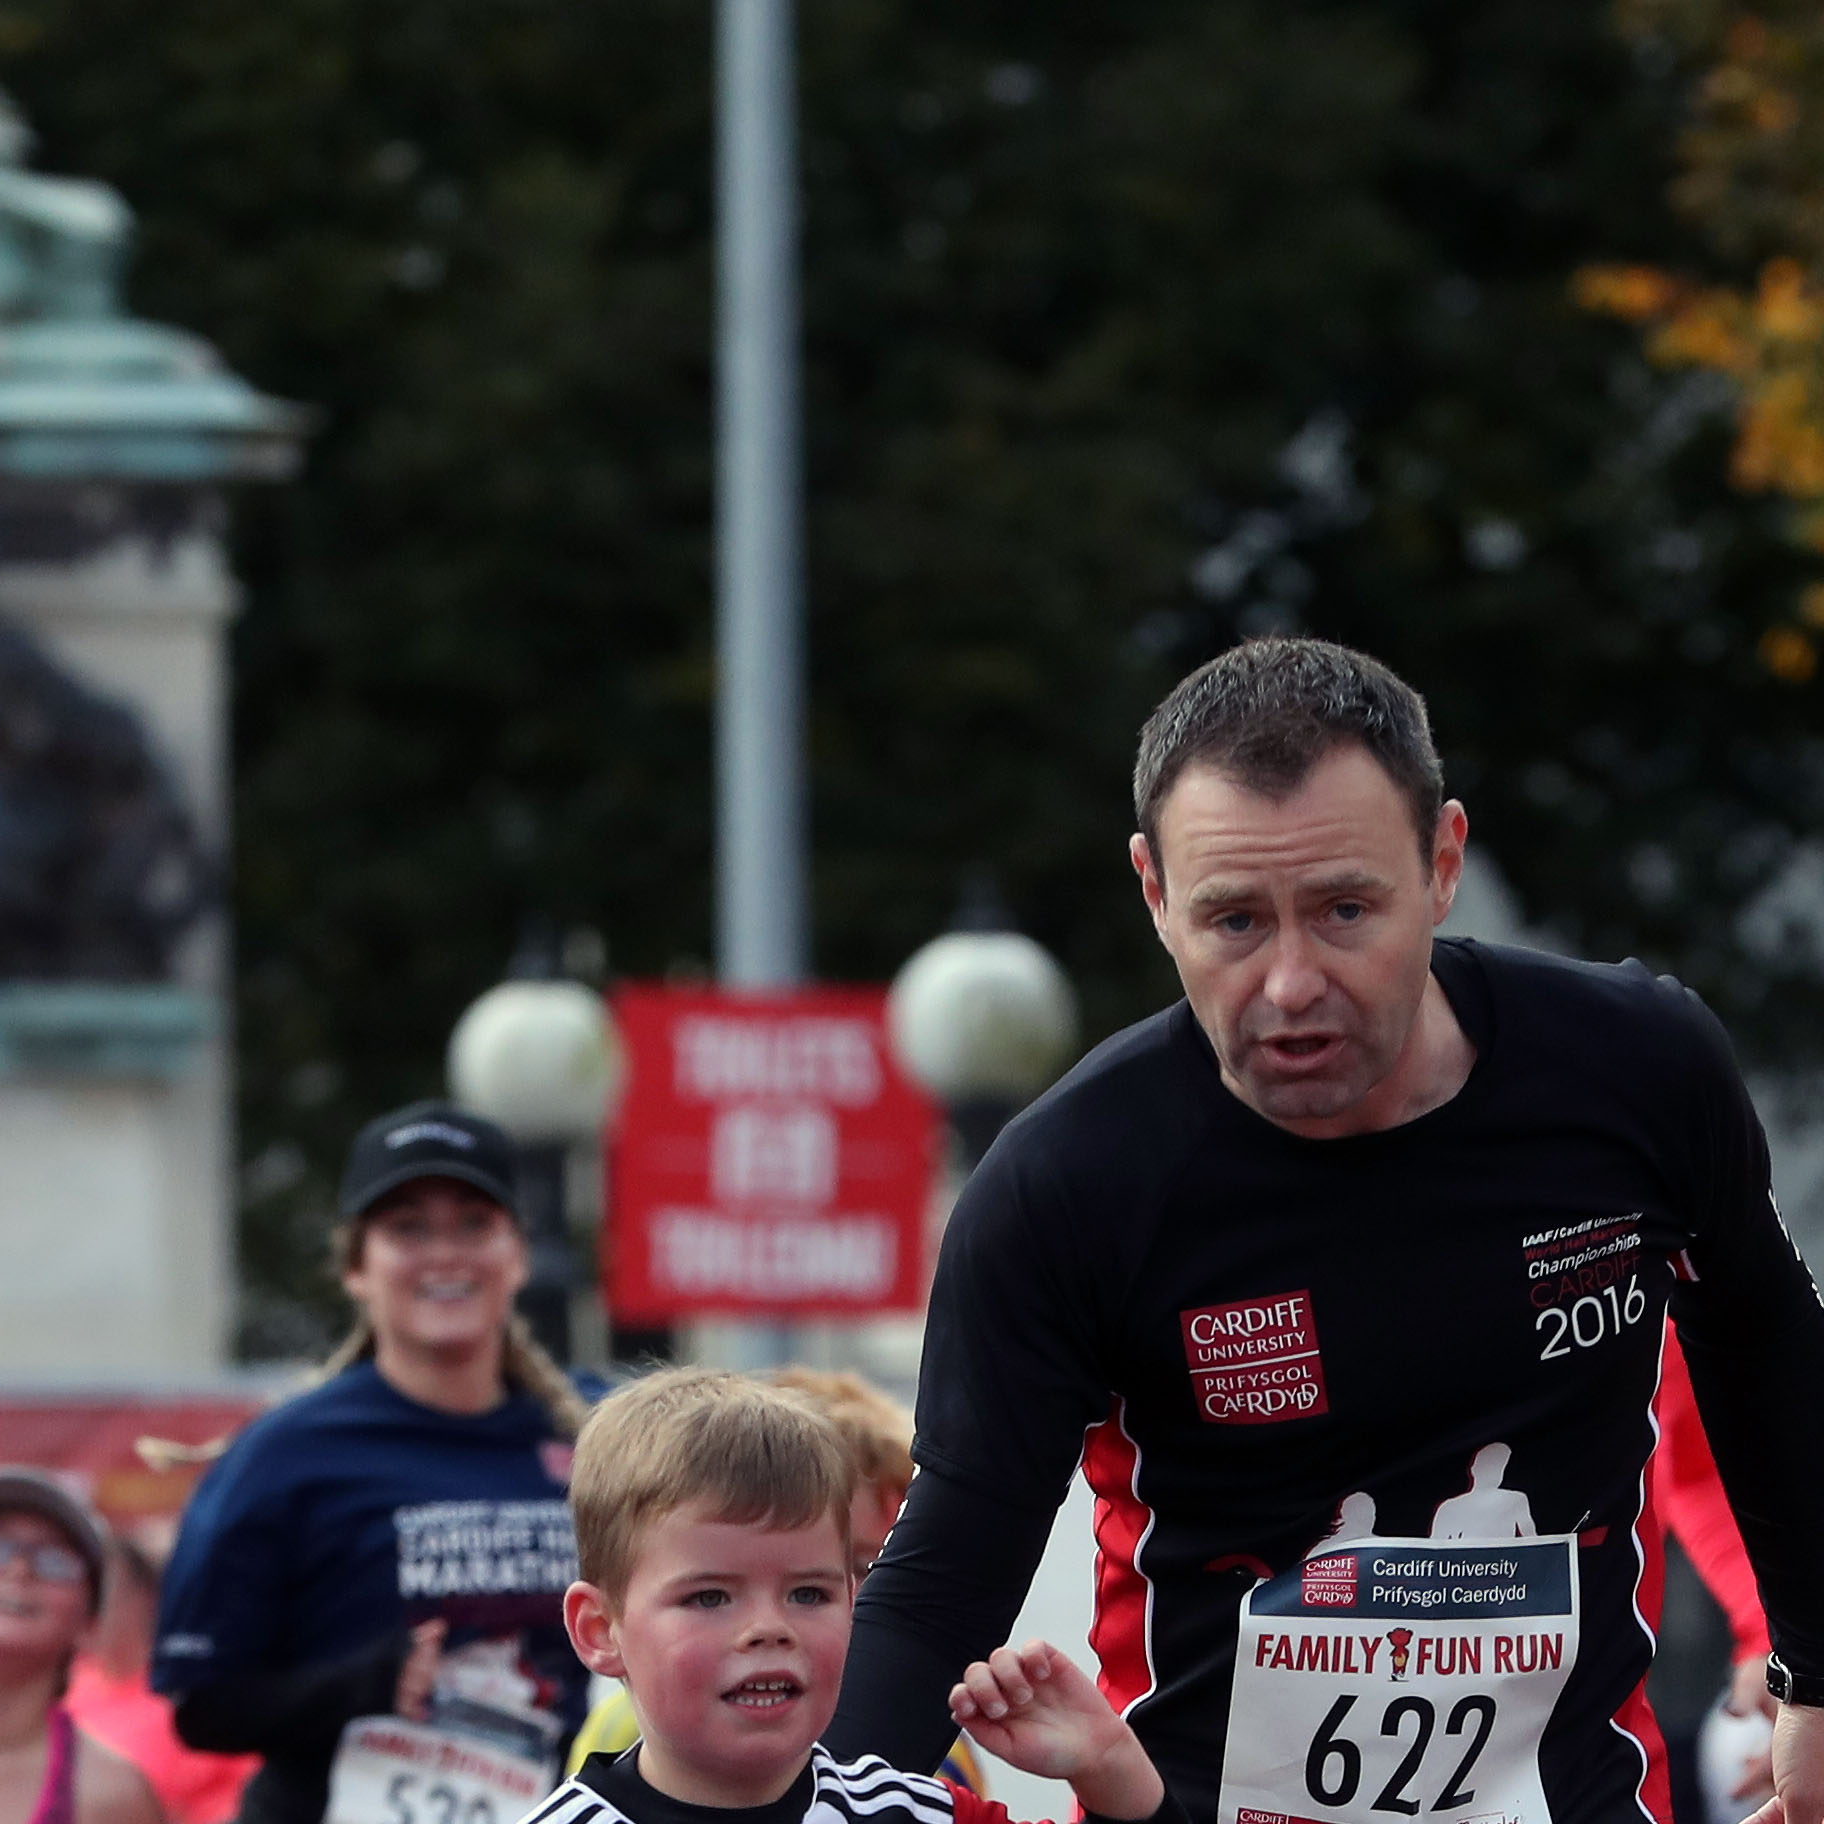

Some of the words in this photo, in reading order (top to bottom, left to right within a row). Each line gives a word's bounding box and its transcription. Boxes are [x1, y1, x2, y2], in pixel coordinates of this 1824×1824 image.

[1528, 1233, 1641, 1279] Championships
[1530, 1253, 1641, 1308] CARDIFF
[1190, 1297, 1304, 1345] CARDIFF
[1536, 1275, 1646, 1360] 2016
[1198, 1331, 1306, 1362] UNIVERSITY
[1204, 1365, 1312, 1391] PRIFYSGOL
[1205, 1382, 1319, 1418] CAERDYDD
[1306, 1558, 1354, 1571] CARDIFF
[1373, 1558, 1435, 1577] Cardiff
[1439, 1559, 1518, 1579] University
[1372, 1586, 1447, 1607] Prifysgol
[1451, 1584, 1526, 1605] Caerdydd
[1255, 1633, 1383, 1674] FAMILY
[1416, 1636, 1482, 1676] FUN
[1493, 1633, 1564, 1675] RUN
[1305, 1694, 1497, 1816] 622
